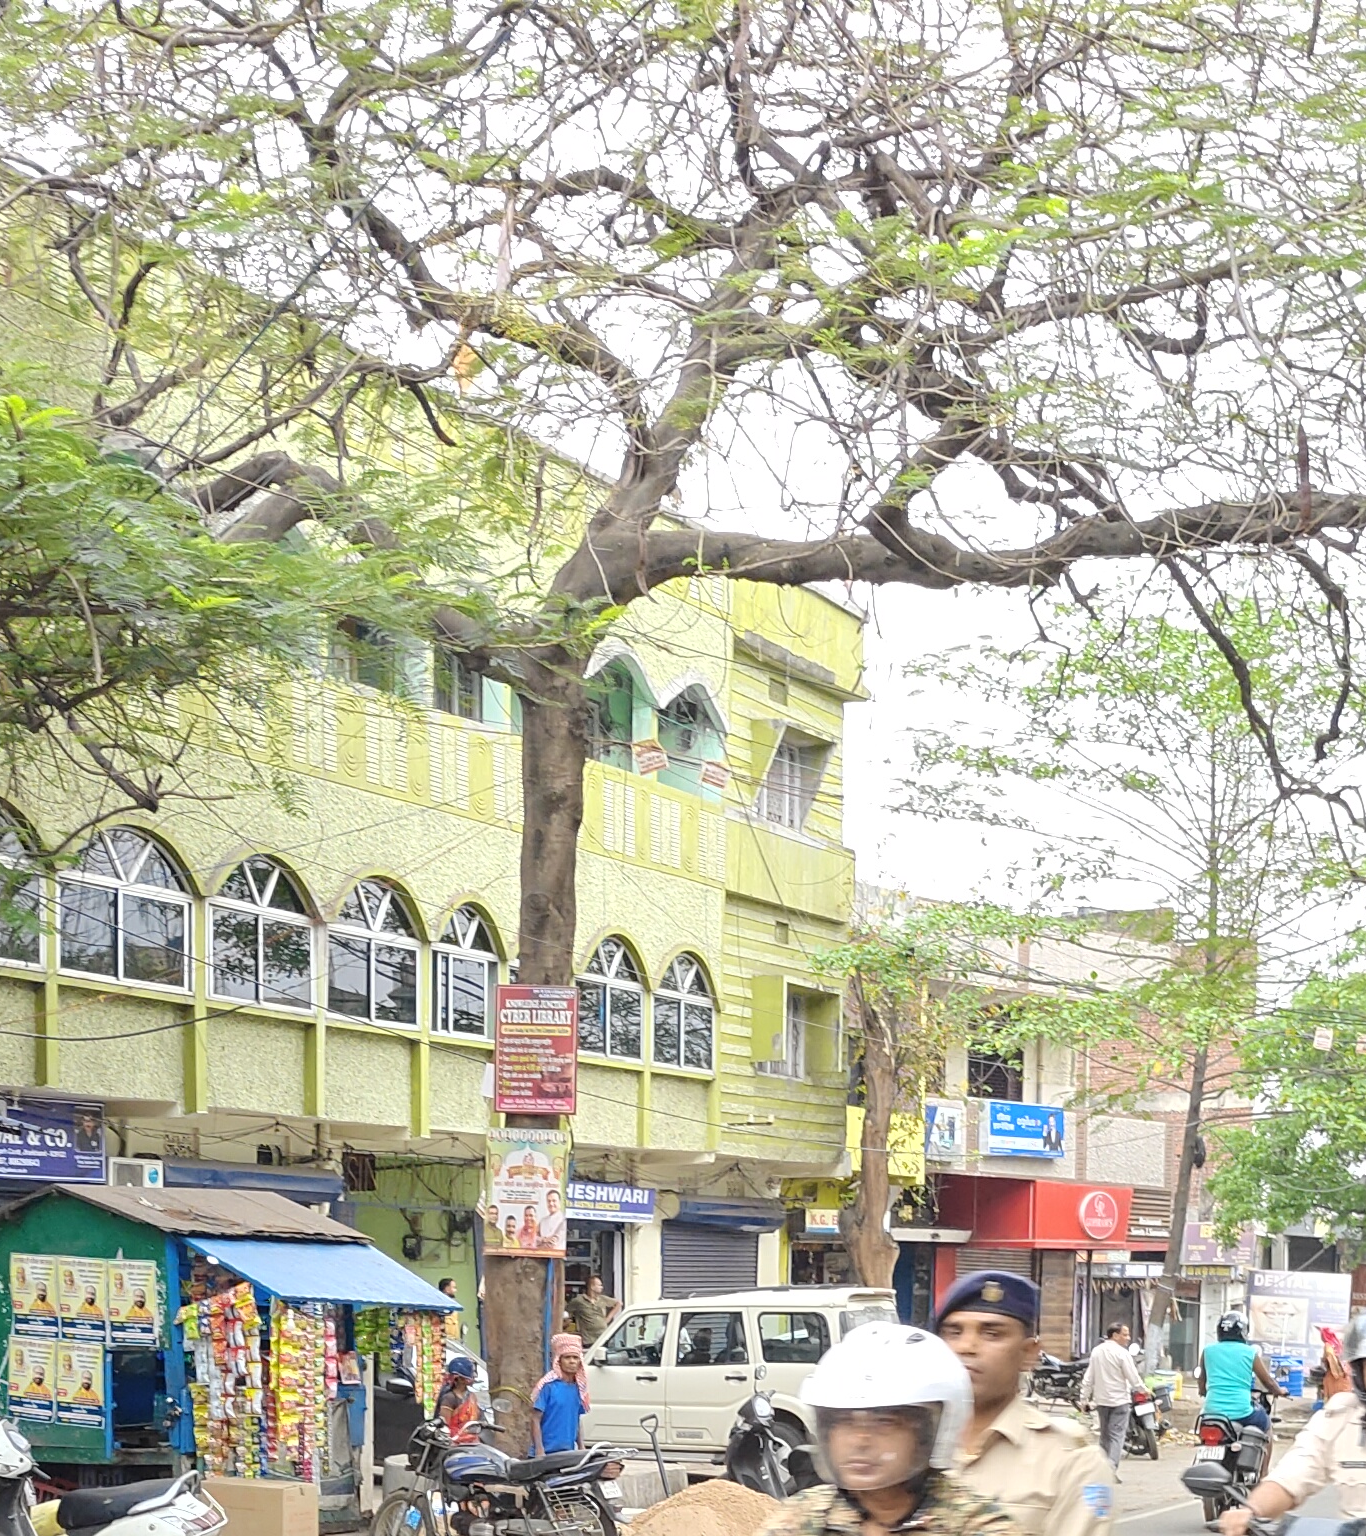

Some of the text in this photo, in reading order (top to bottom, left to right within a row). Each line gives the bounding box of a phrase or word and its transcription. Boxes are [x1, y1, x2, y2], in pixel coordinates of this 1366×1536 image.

[500, 1008, 574, 1025] CYBER LIBRARY
[26, 1129, 42, 1147] &
[43, 1127, 73, 1148] CO.
